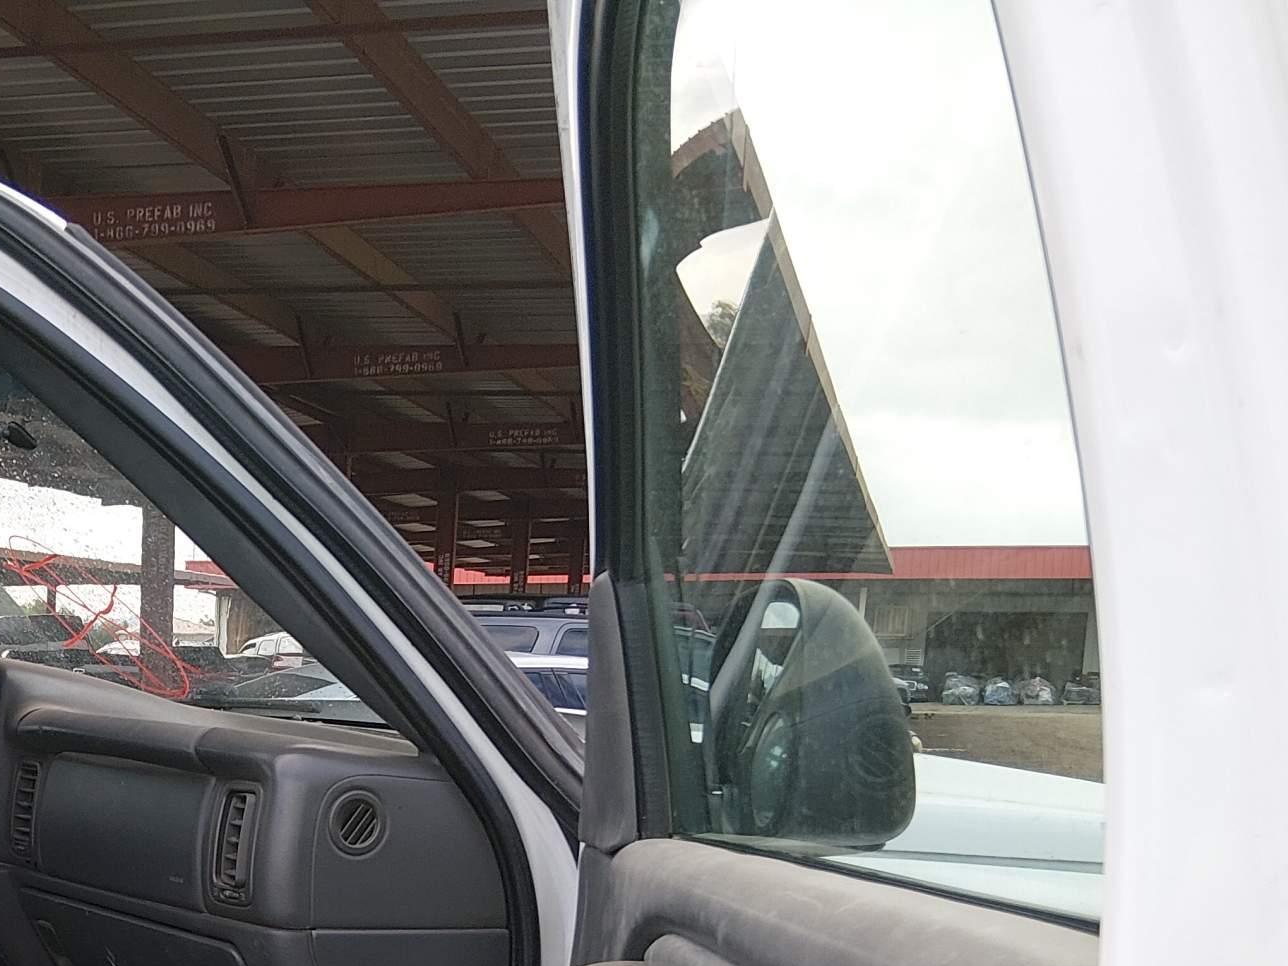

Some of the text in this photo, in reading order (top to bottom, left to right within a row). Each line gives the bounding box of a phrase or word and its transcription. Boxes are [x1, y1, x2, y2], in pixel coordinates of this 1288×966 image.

[93, 202, 213, 225] U.S. PREFAB INC
